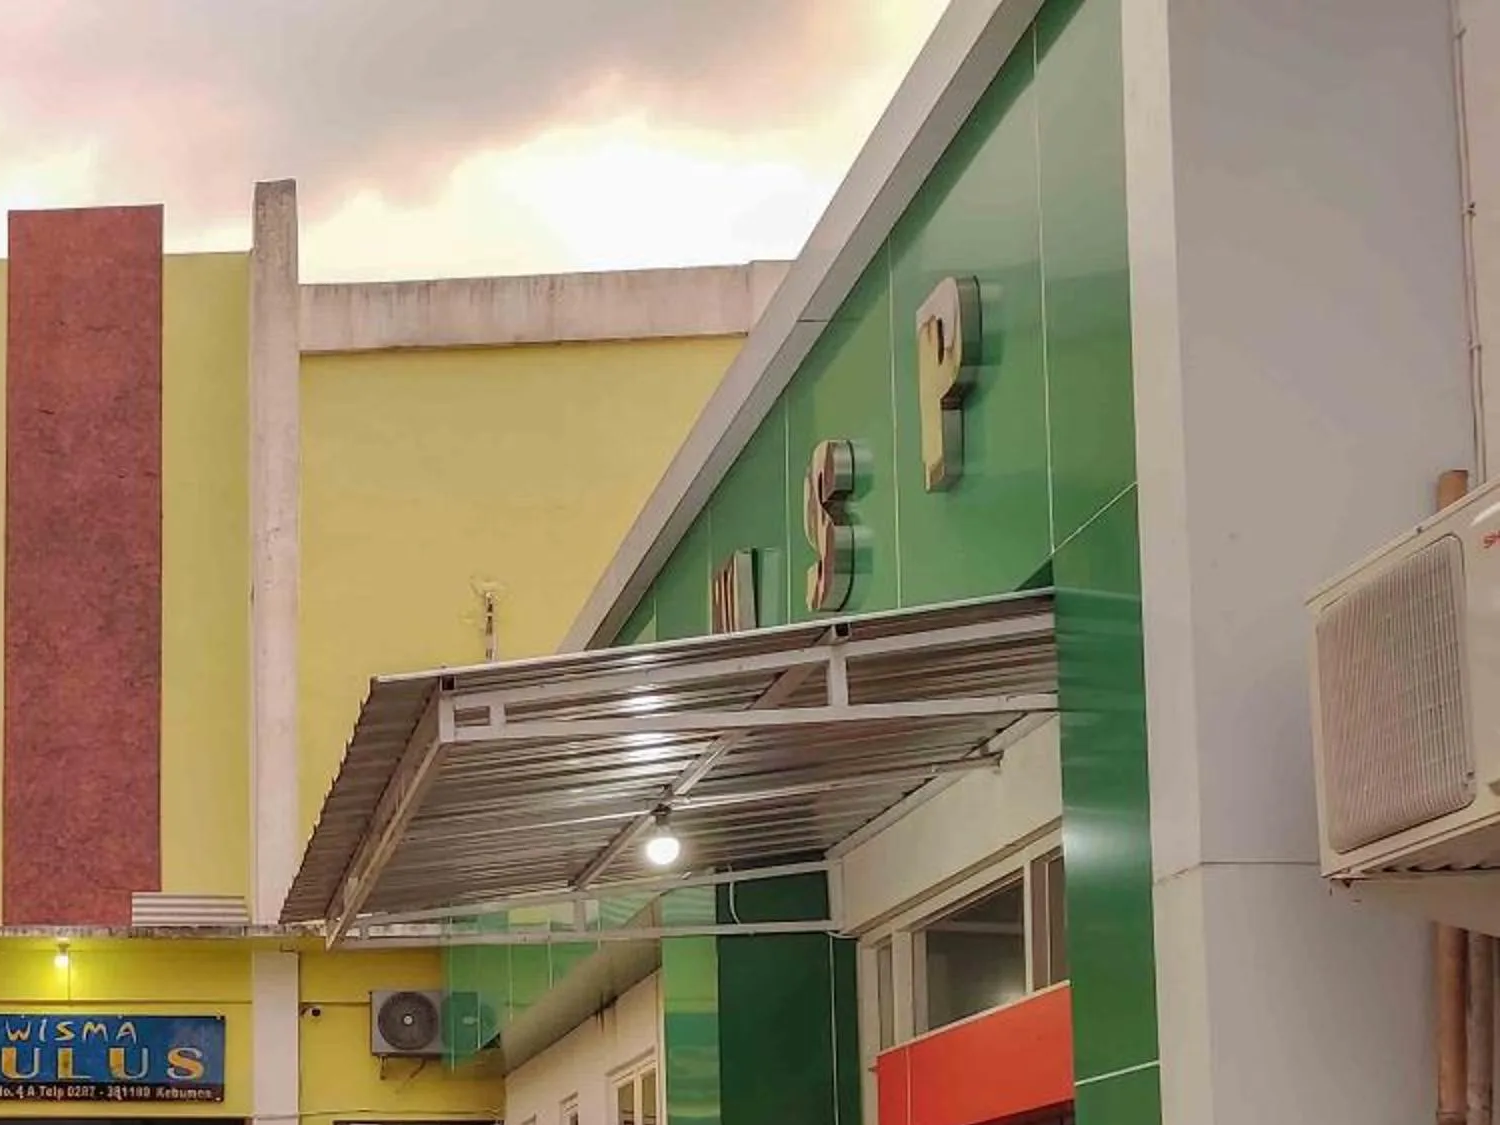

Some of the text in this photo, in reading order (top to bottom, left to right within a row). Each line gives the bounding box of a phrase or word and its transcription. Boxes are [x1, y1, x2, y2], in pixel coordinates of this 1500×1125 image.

[4, 1019, 138, 1044] WISMA
[27, 1084, 36, 1097] A
[39, 1084, 65, 1100] Telp
